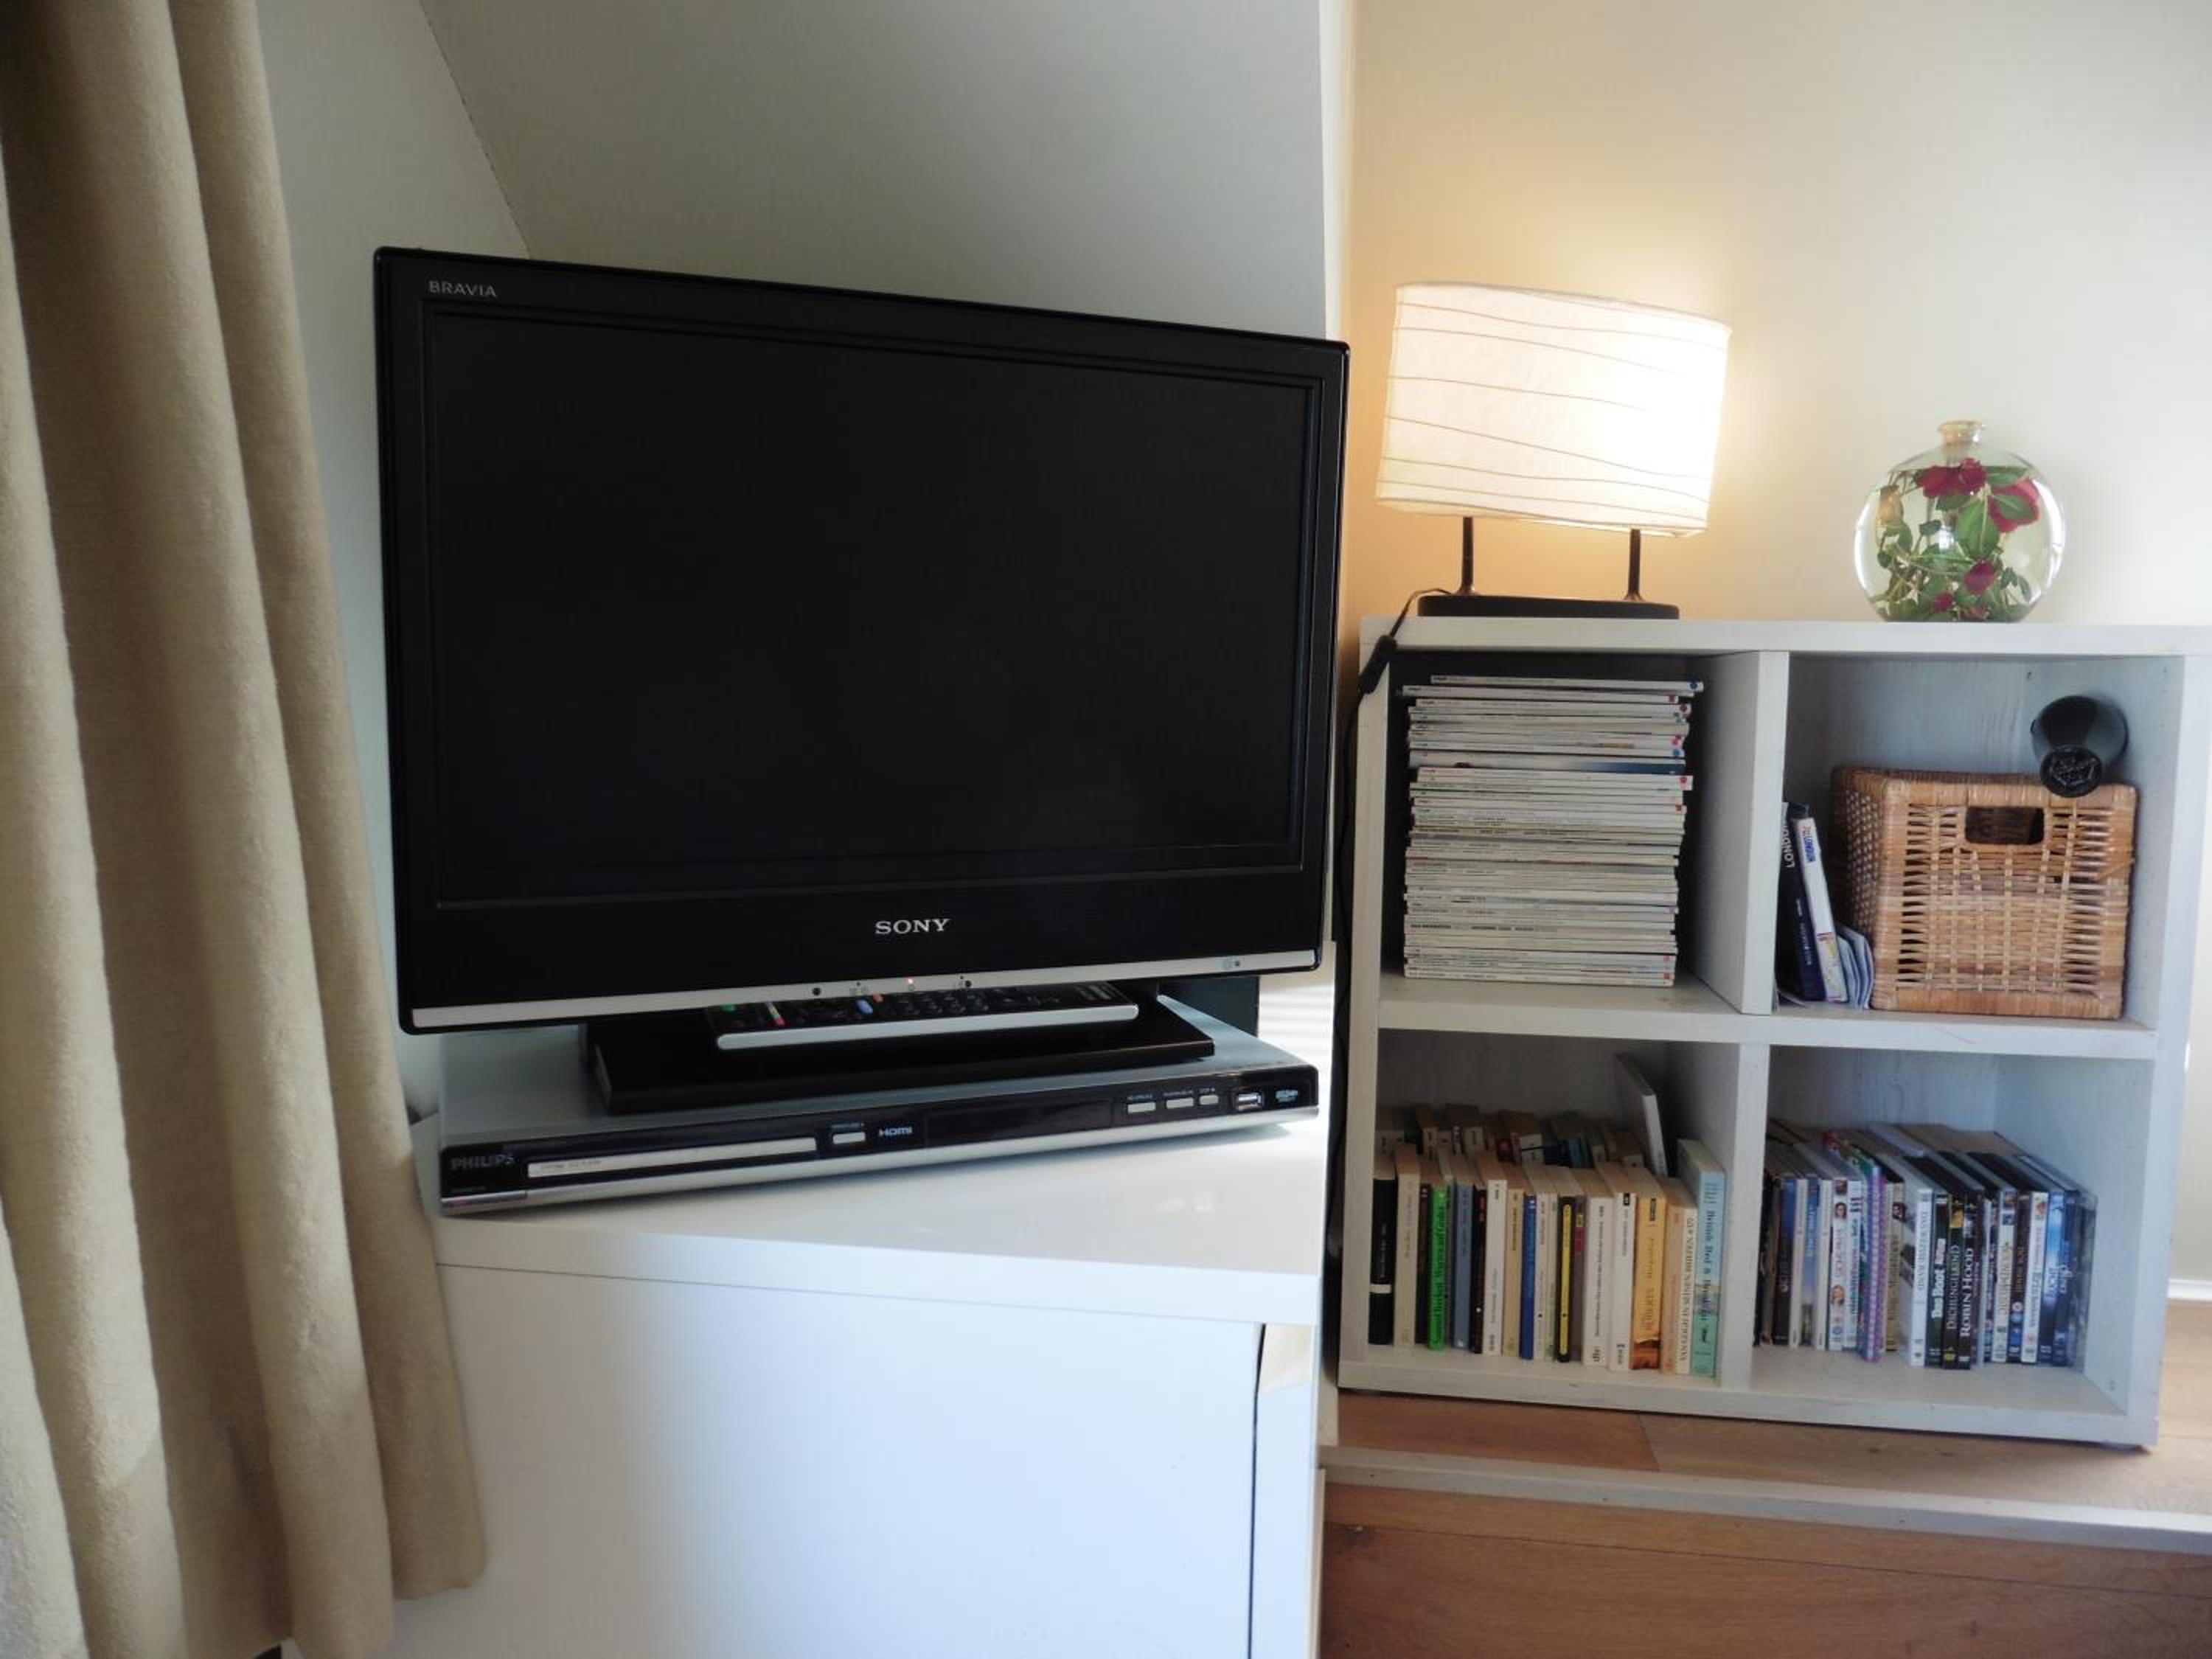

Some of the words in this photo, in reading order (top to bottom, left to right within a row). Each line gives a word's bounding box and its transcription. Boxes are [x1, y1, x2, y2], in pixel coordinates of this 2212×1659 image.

[428, 280, 497, 297] BRAVIA
[874, 918, 951, 935] SONY
[878, 1126, 914, 1137] HDMI
[450, 1153, 515, 1171] PHILIPS
[1704, 1245, 1714, 1264] Bed
[1962, 1248, 1973, 1290] HOOD
[1932, 1268, 1945, 1297] Boot
[1931, 1298, 1943, 1318] Das
[1960, 1291, 1972, 1338] ROBIN
